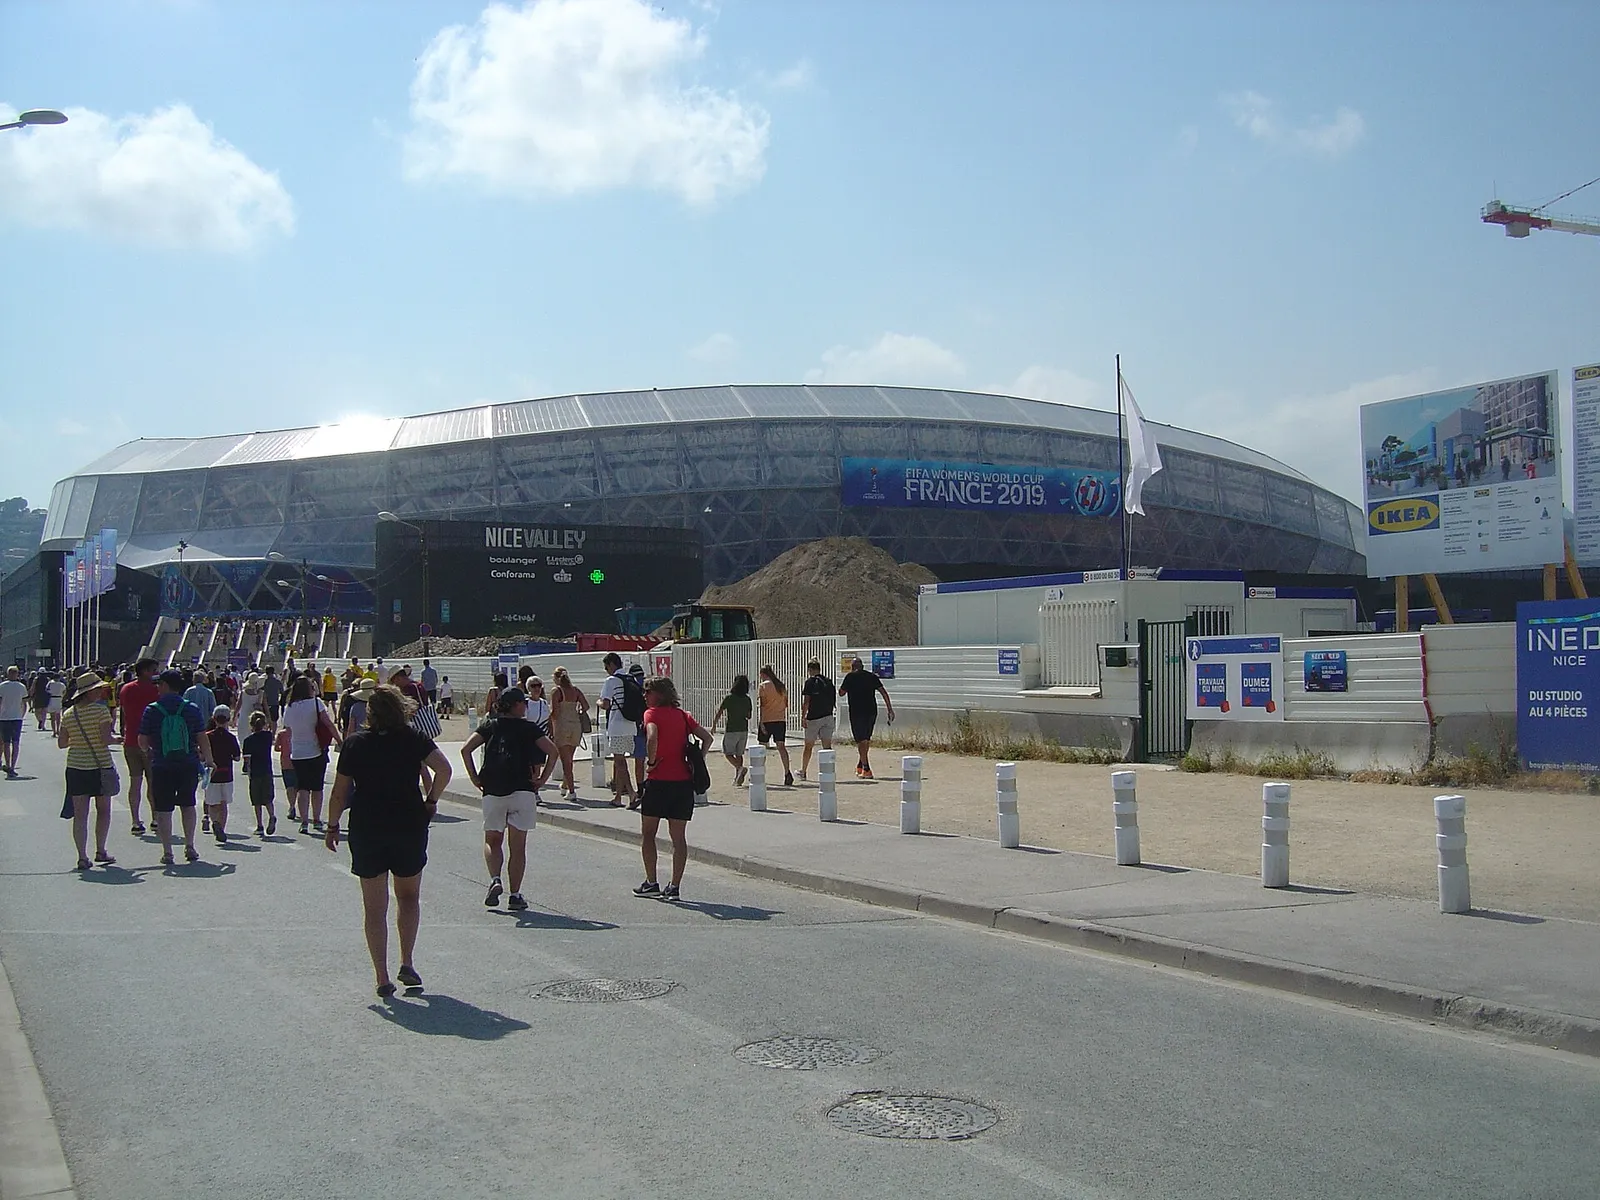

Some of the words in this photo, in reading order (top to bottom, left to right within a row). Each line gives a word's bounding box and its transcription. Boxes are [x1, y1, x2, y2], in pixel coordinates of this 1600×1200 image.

[905, 467, 930, 479] FIFA
[931, 469, 981, 482] WOMEN'S
[982, 472, 1021, 484] WORLD
[1022, 474, 1045, 485] CUP
[902, 478, 994, 505] FRANCE
[997, 483, 1045, 506] 2019
[1377, 505, 1432, 525] IKEA
[489, 556, 538, 566] boulanger
[490, 569, 536, 579] Conforama
[1553, 655, 1587, 666] NICE
[1198, 678, 1225, 686] TRAVAUX
[1243, 677, 1270, 687] DUMEZ
[1202, 685, 1211, 693] DU
[1211, 685, 1225, 693] MIDI
[1529, 691, 1544, 701] DU
[1545, 690, 1583, 701] STUDIO
[1529, 707, 1544, 717] AU
[1545, 707, 1553, 717] 4
[1554, 704, 1588, 717] PIÈCES
